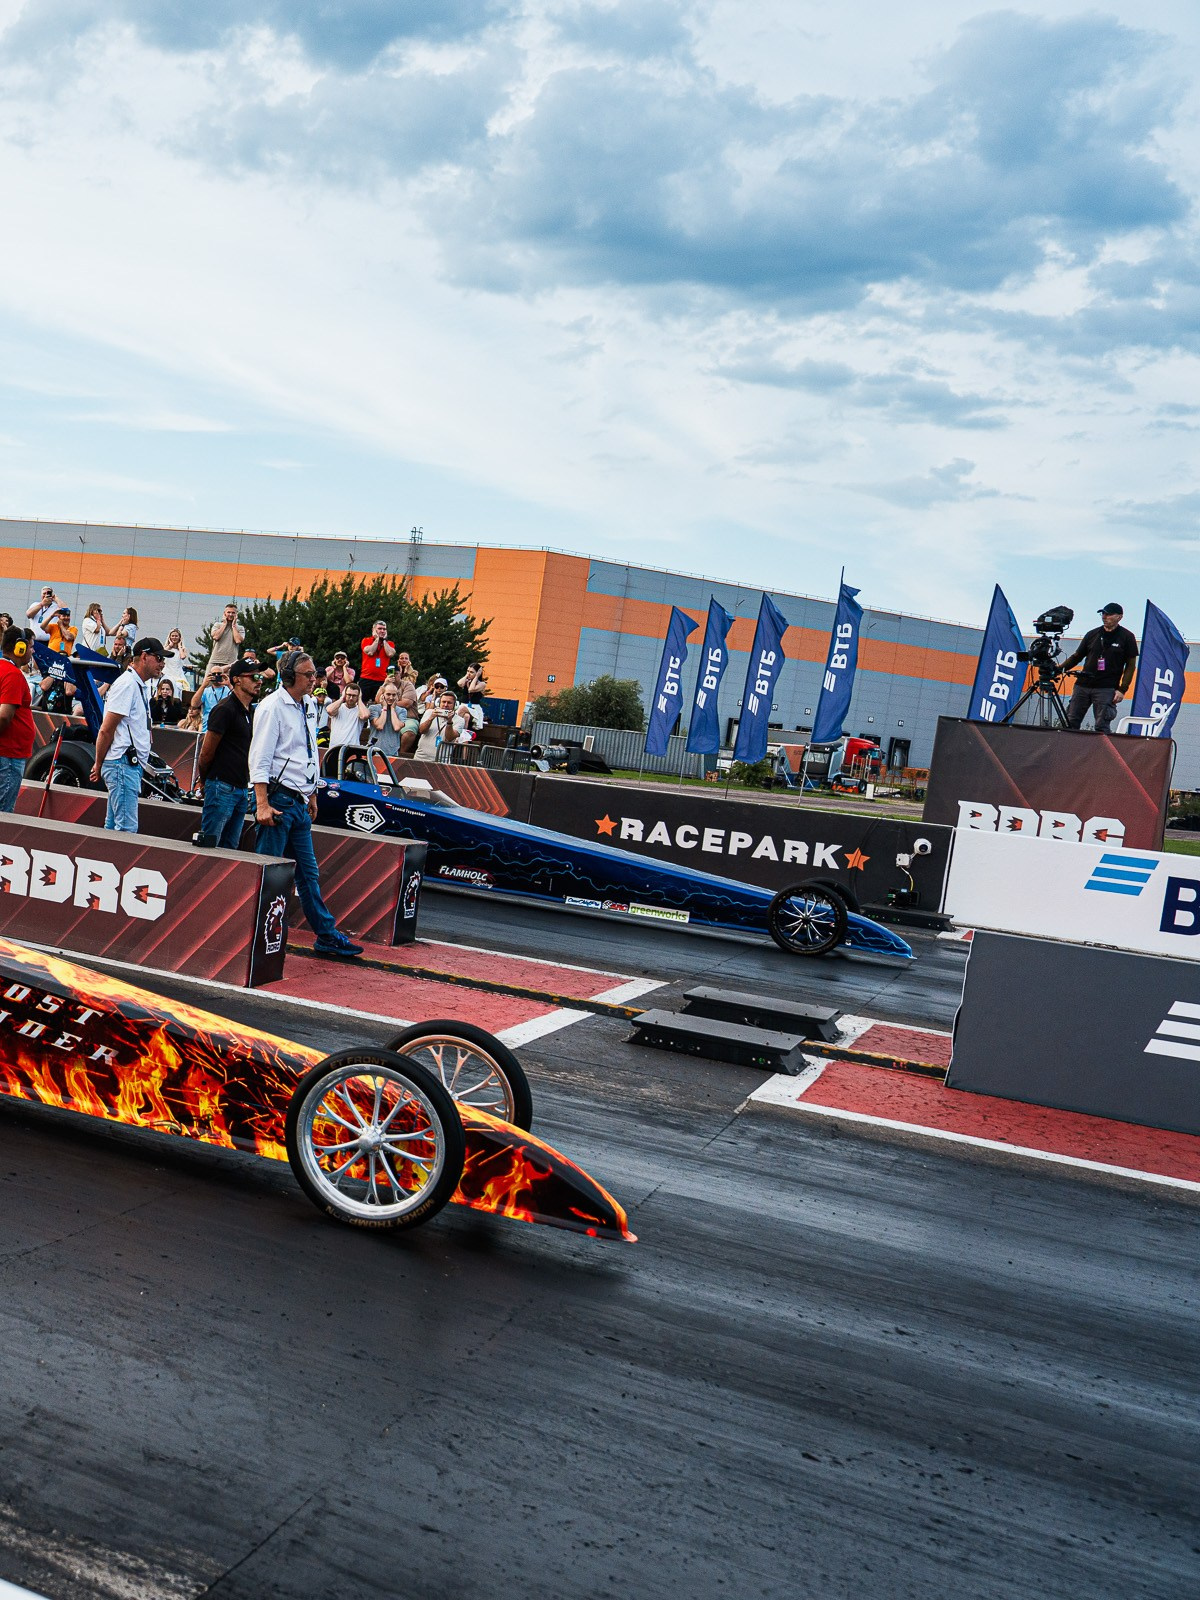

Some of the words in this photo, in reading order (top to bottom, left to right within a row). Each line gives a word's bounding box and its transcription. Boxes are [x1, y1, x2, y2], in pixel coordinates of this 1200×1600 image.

[358, 812, 376, 824] 799
[619, 817, 843, 870] RACEPARK
[630, 904, 688, 922] greenworks
[346, 1056, 388, 1066] FRONT
[396, 1199, 435, 1225] MICKEY
